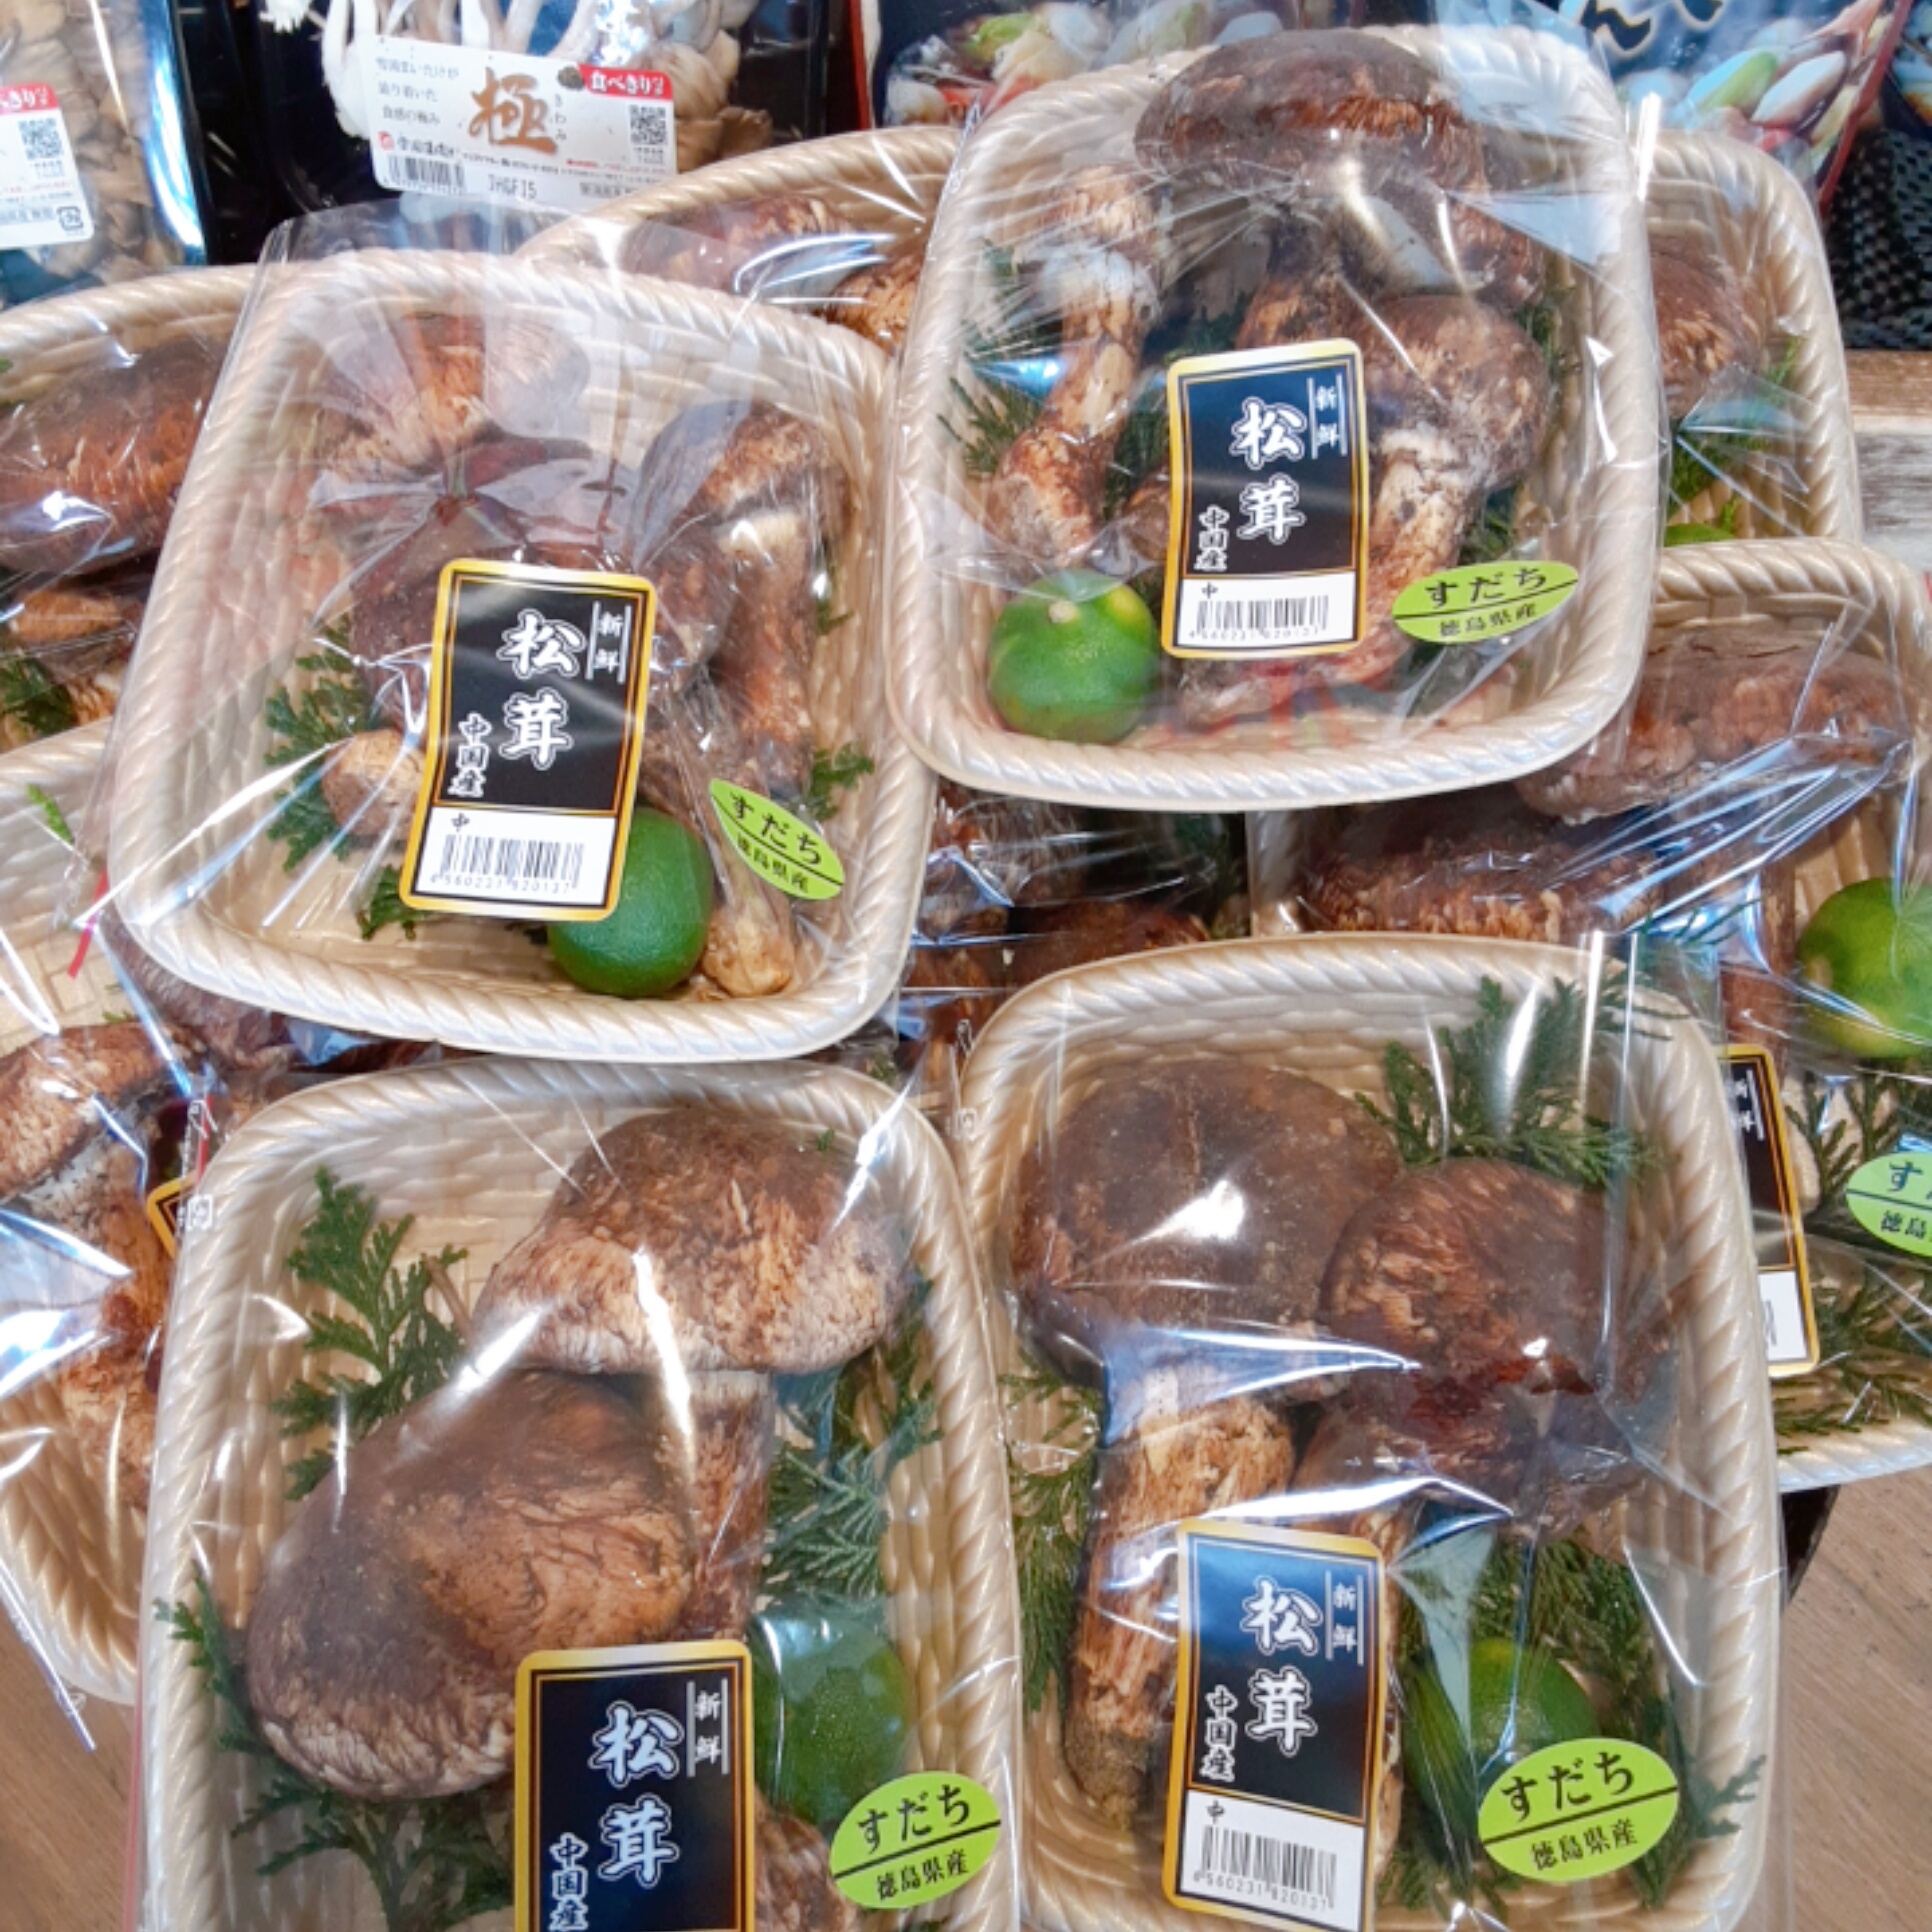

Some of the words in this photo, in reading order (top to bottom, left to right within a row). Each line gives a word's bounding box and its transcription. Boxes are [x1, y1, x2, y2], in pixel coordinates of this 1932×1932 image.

[468, 66, 558, 154] 極
[1228, 396, 1308, 545] 松茸
[1194, 504, 1230, 572] 中国産
[1201, 582, 1218, 598] 中
[1425, 567, 1546, 609] すだち
[1440, 603, 1536, 637] 徳島県産
[597, 613, 624, 674] 新鮮
[496, 608, 586, 771] 松茸
[447, 711, 492, 798] 中国産
[452, 813, 470, 831] 中
[730, 791, 821, 865] すだち
[737, 832, 808, 894] 徳島県産
[1889, 1160, 1932, 1200] す
[1881, 1209, 1932, 1241] 徳島
[1239, 1575, 1322, 1757] 松茸
[695, 1690, 720, 1764] 新鮮
[1200, 1685, 1239, 1783] 中国産
[587, 1700, 685, 1889] 松茸
[858, 1784, 970, 1854] すだち
[1207, 1800, 1225, 1824] 中
[1501, 1751, 1634, 1823] すだち
[877, 1848, 968, 1901] 徳島県産
[1532, 1818, 1638, 1871] 徳島県産
[548, 1832, 588, 1932] 中国産
